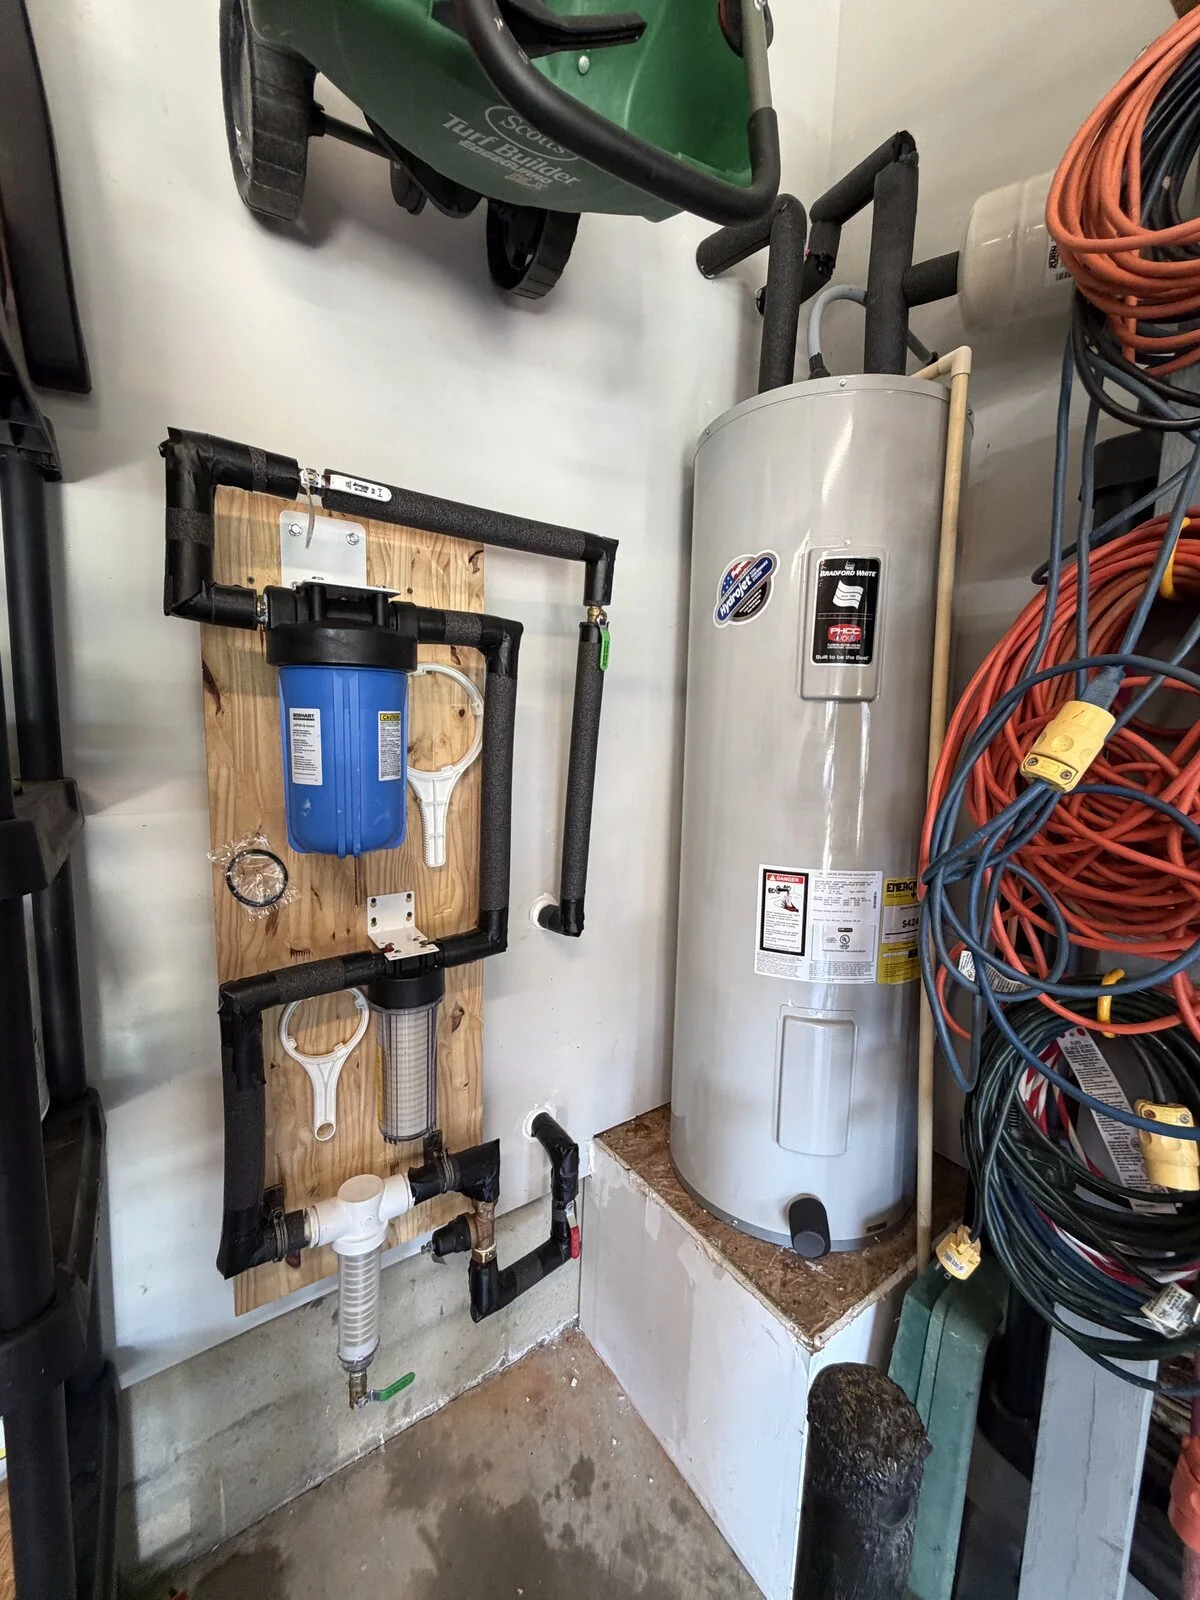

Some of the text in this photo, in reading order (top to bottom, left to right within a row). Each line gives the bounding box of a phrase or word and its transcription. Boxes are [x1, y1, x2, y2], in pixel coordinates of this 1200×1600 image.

[442, 113, 500, 146] Turf
[493, 143, 581, 184] Builder
[820, 570, 878, 578] BRADFORD WHITE
[719, 574, 752, 617] Hydrojet
[830, 627, 861, 635] PHCC
[776, 875, 800, 883] DANGER
